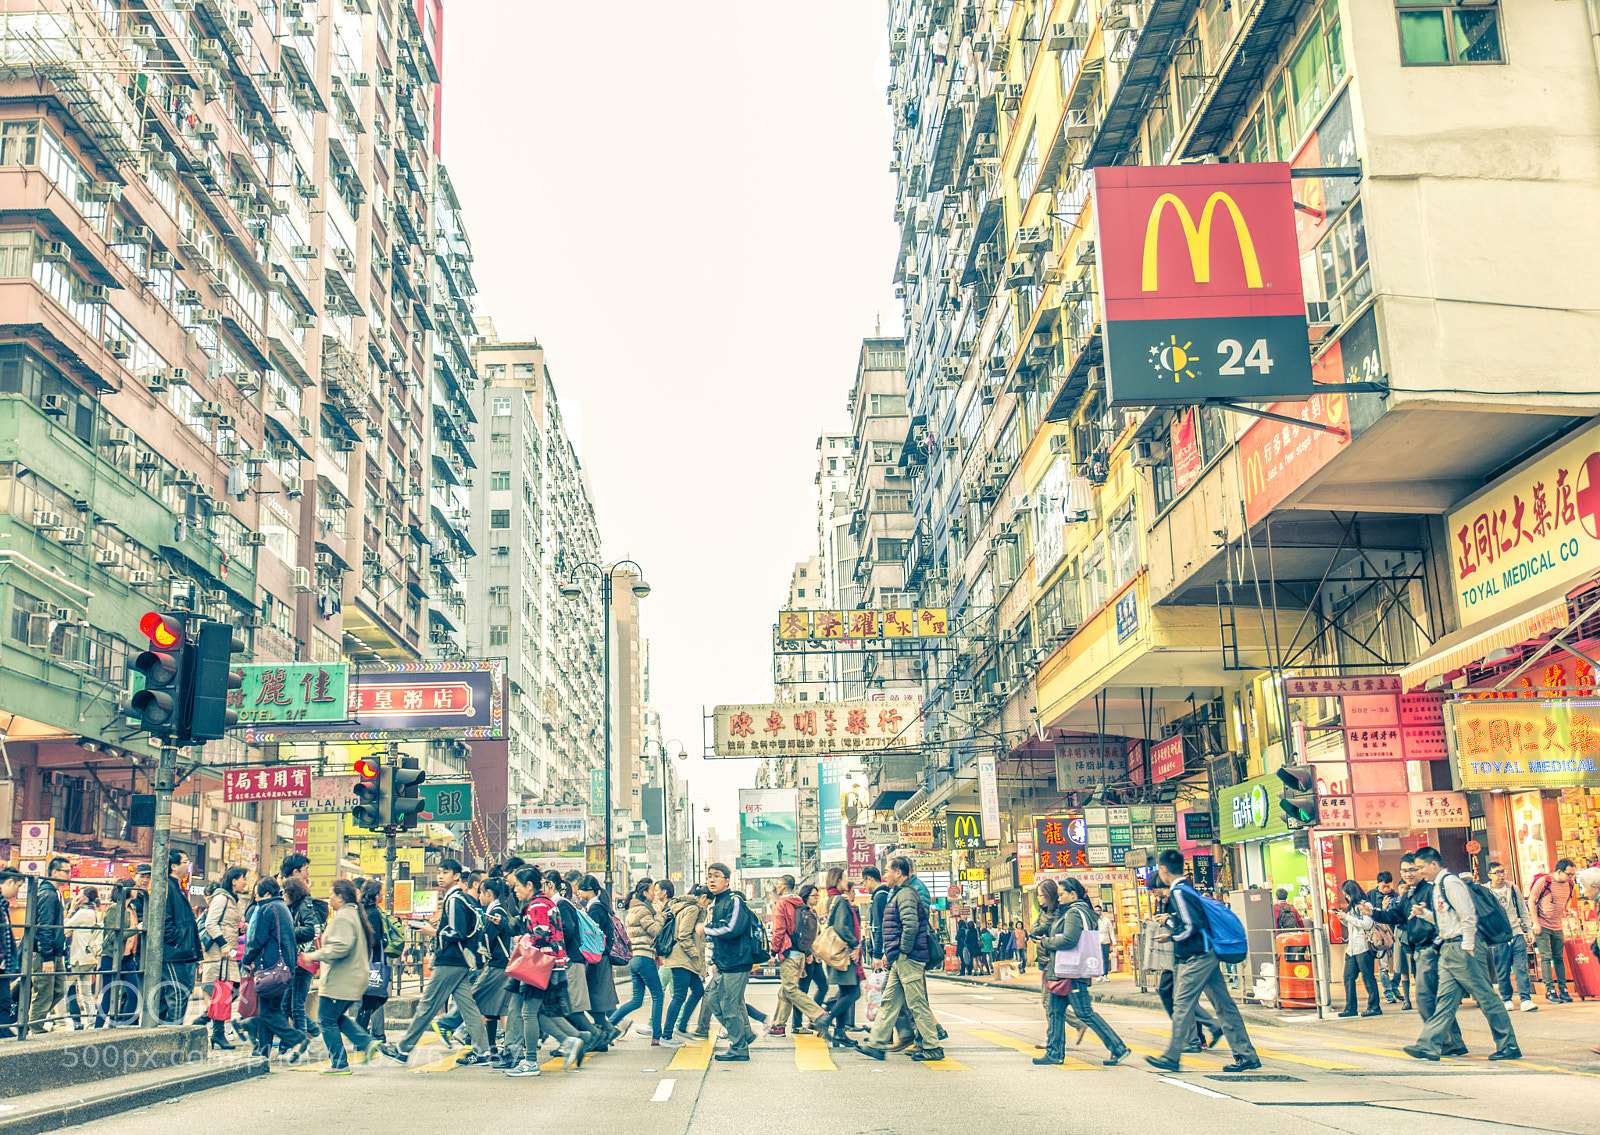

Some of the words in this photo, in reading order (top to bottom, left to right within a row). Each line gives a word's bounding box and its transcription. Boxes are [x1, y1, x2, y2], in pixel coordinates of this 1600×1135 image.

[1216, 339, 1274, 375] 24
[1457, 469, 1575, 580] 正同仁大藥店
[1462, 578, 1500, 608] TOYAL
[1502, 550, 1556, 589] MEDICAL
[1560, 538, 1579, 561] CO
[236, 710, 276, 720] OTEL
[286, 709, 307, 720] 2/F
[1470, 761, 1525, 775] TOYAL
[1528, 758, 1599, 773] MEDICAL
[291, 800, 309, 808] KEI
[317, 799, 336, 807] LAI
[967, 838, 980, 847] 24
